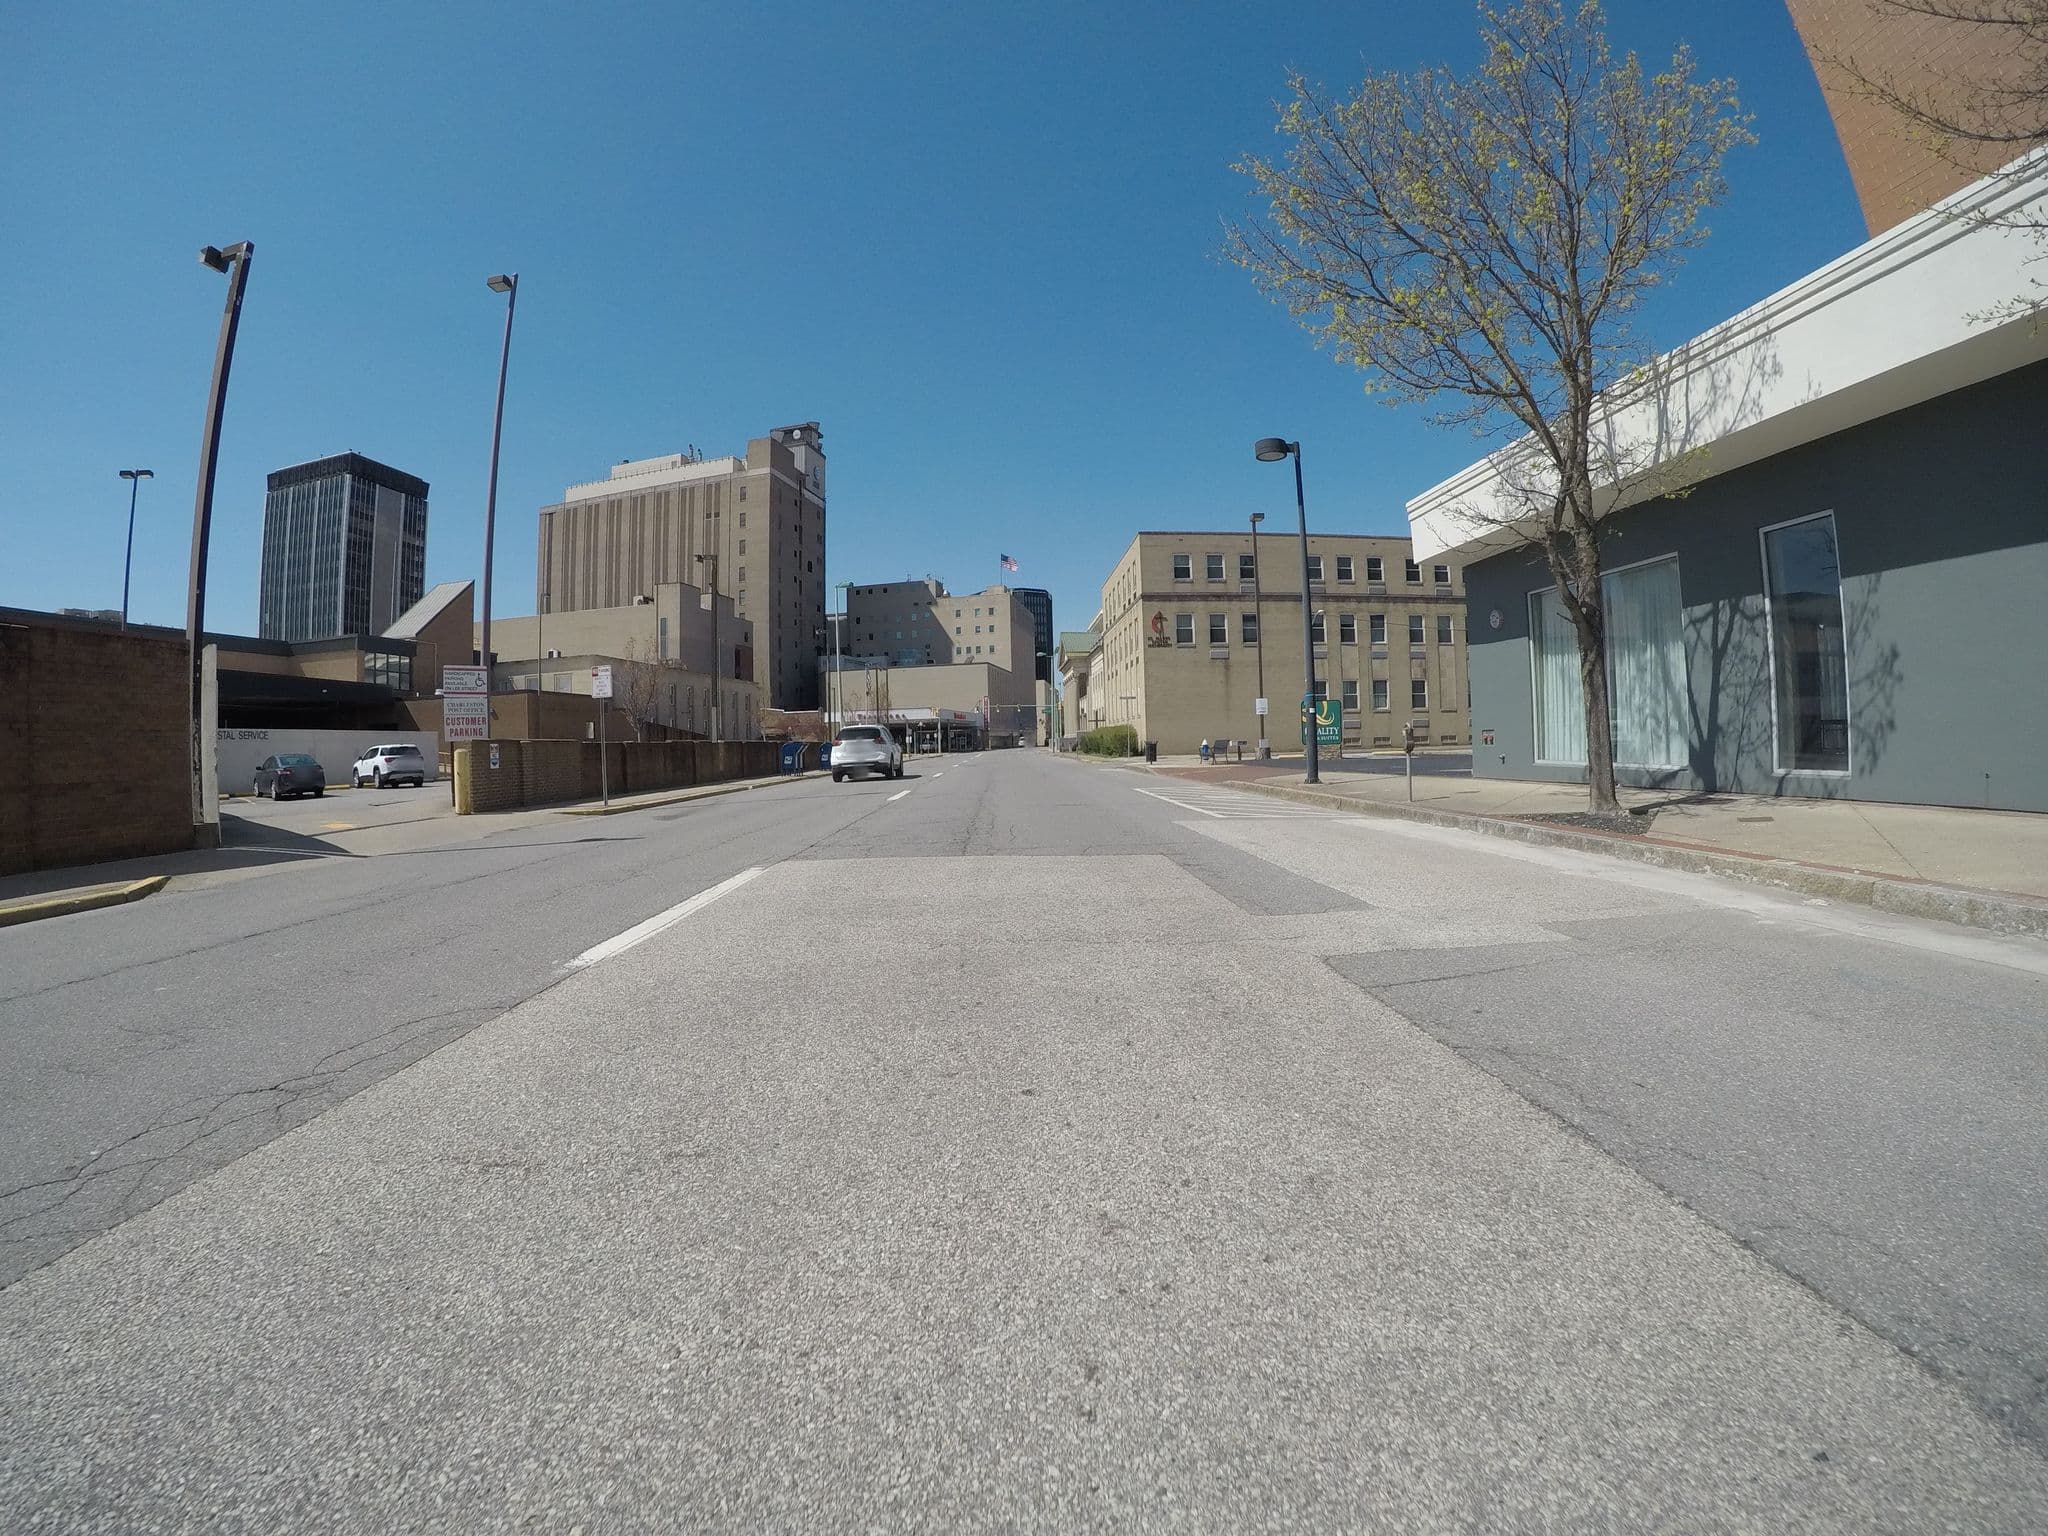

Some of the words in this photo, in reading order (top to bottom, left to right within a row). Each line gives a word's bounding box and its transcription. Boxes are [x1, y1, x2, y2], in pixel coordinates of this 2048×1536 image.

[445, 716, 487, 726] CUSTOMER
[238, 730, 269, 740] SERVICE
[449, 727, 484, 737] PARKING
